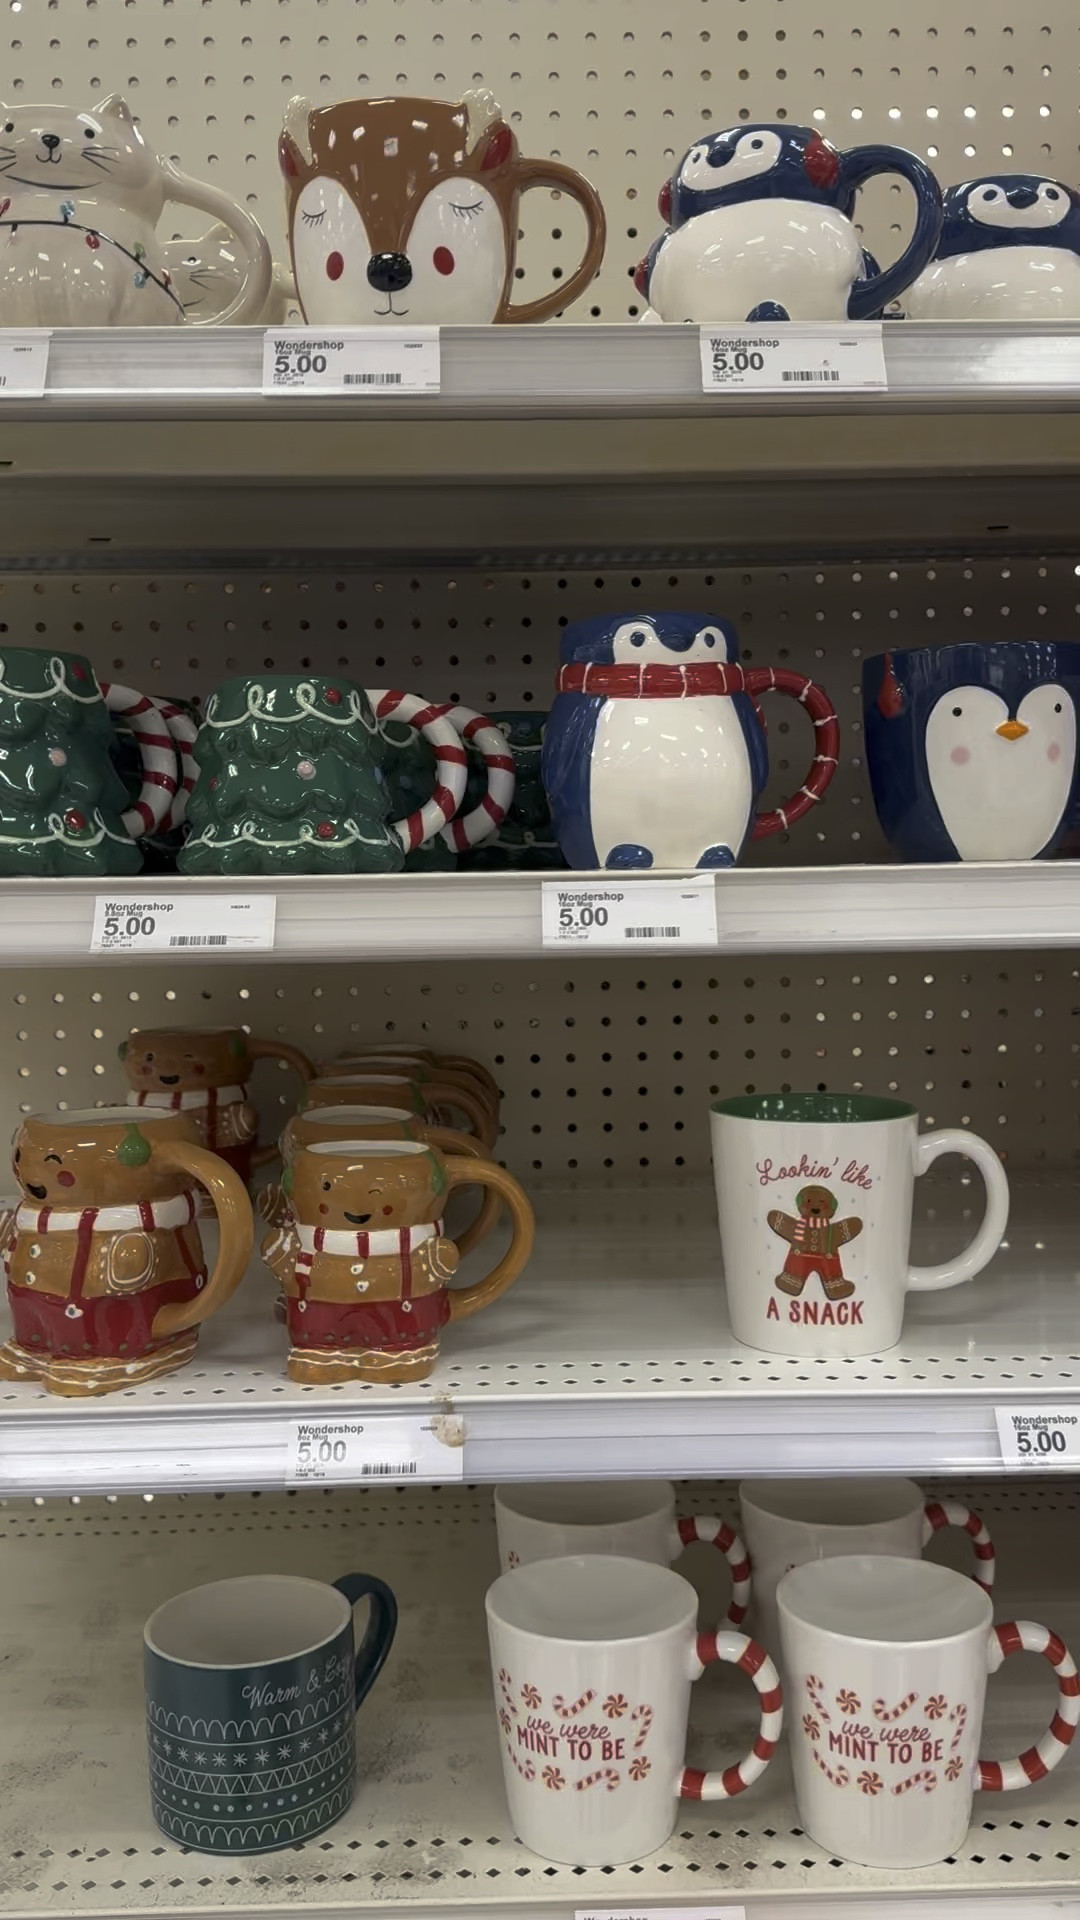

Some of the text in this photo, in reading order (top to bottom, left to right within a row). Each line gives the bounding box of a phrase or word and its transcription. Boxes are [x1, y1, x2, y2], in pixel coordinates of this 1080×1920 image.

[274, 340, 344, 351] Wondershop
[710, 338, 779, 348] Wondershop
[274, 355, 327, 373] 5.00
[713, 352, 764, 370] 5.00
[558, 892, 624, 902] Wondershop
[105, 903, 174, 912] Wondershop
[560, 907, 608, 926] 5.00
[104, 917, 155, 936] 5.00
[757, 1154, 872, 1190] Lookin' like
[767, 1296, 864, 1326] A SNACK
[298, 1424, 364, 1435] Wondershop
[1011, 1415, 1078, 1425] Wondershop
[298, 1440, 346, 1462] 5.00
[1017, 1431, 1066, 1453] 5.00
[242, 1682, 300, 1710] Warm
[307, 1668, 321, 1693] &
[527, 1715, 611, 1740] we were
[842, 1721, 931, 1742] we were
[517, 1725, 625, 1761] MINT TO BE
[829, 1730, 944, 1764] MINT TO BE
